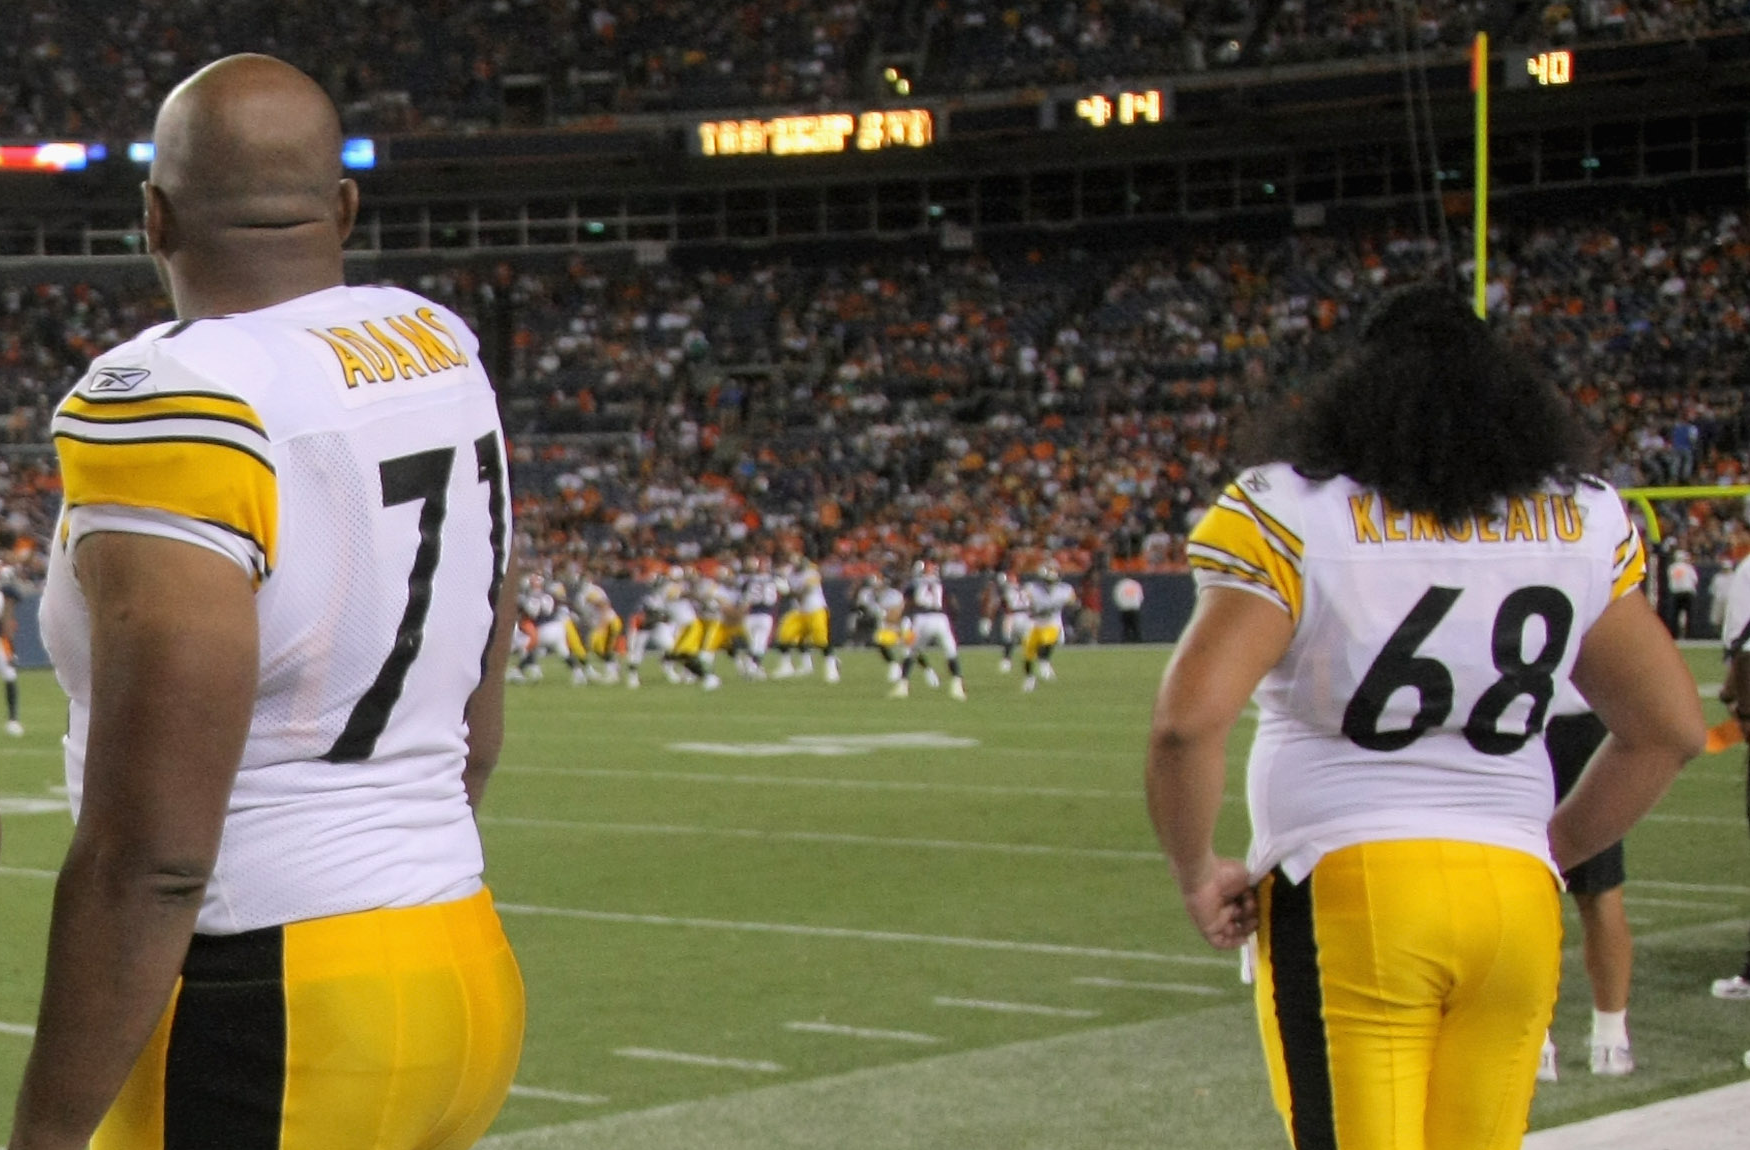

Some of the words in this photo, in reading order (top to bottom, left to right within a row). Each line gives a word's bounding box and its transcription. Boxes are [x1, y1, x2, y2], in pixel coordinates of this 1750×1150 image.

[1527, 50, 1570, 86] 40
[305, 307, 469, 389] ADAMS
[1341, 585, 1576, 756] 68
